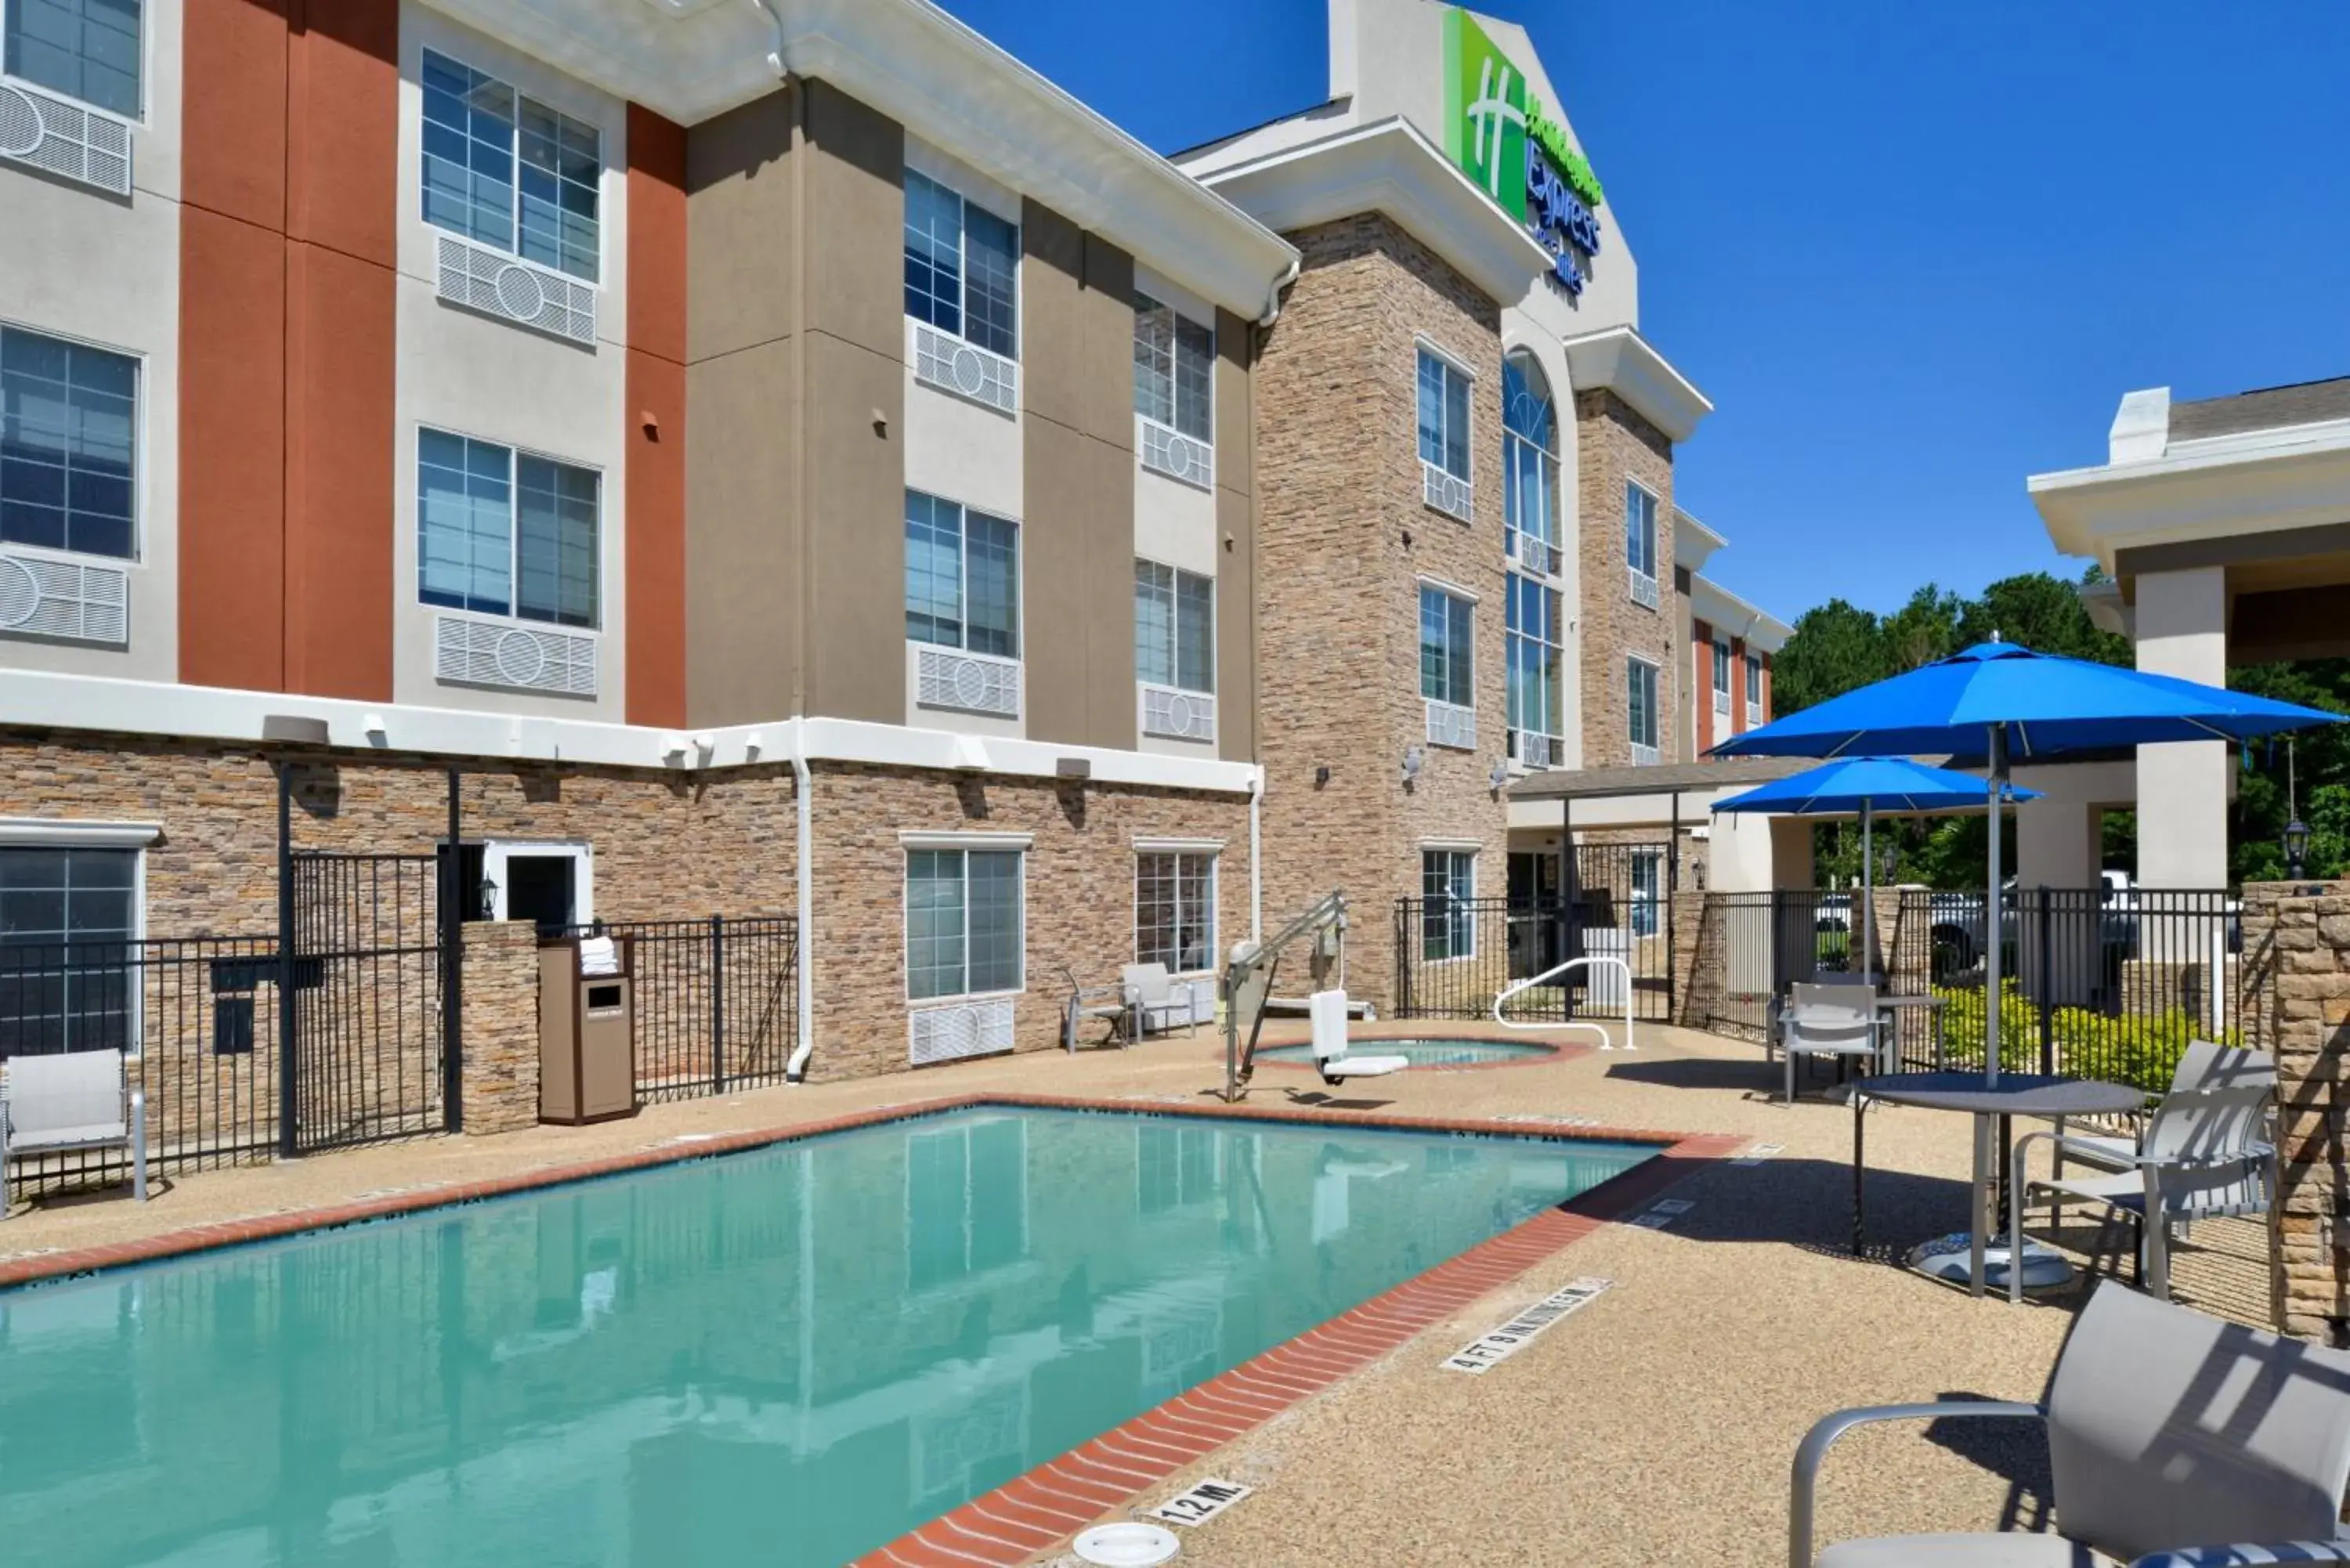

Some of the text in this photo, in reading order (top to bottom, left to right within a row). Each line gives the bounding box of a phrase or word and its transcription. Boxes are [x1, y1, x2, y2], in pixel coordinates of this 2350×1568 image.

[1526, 137, 1601, 258] Express
[1463, 1343, 1505, 1360] FT
[1452, 1359, 1484, 1367] 4
[1161, 1499, 1216, 1521] 1.2
